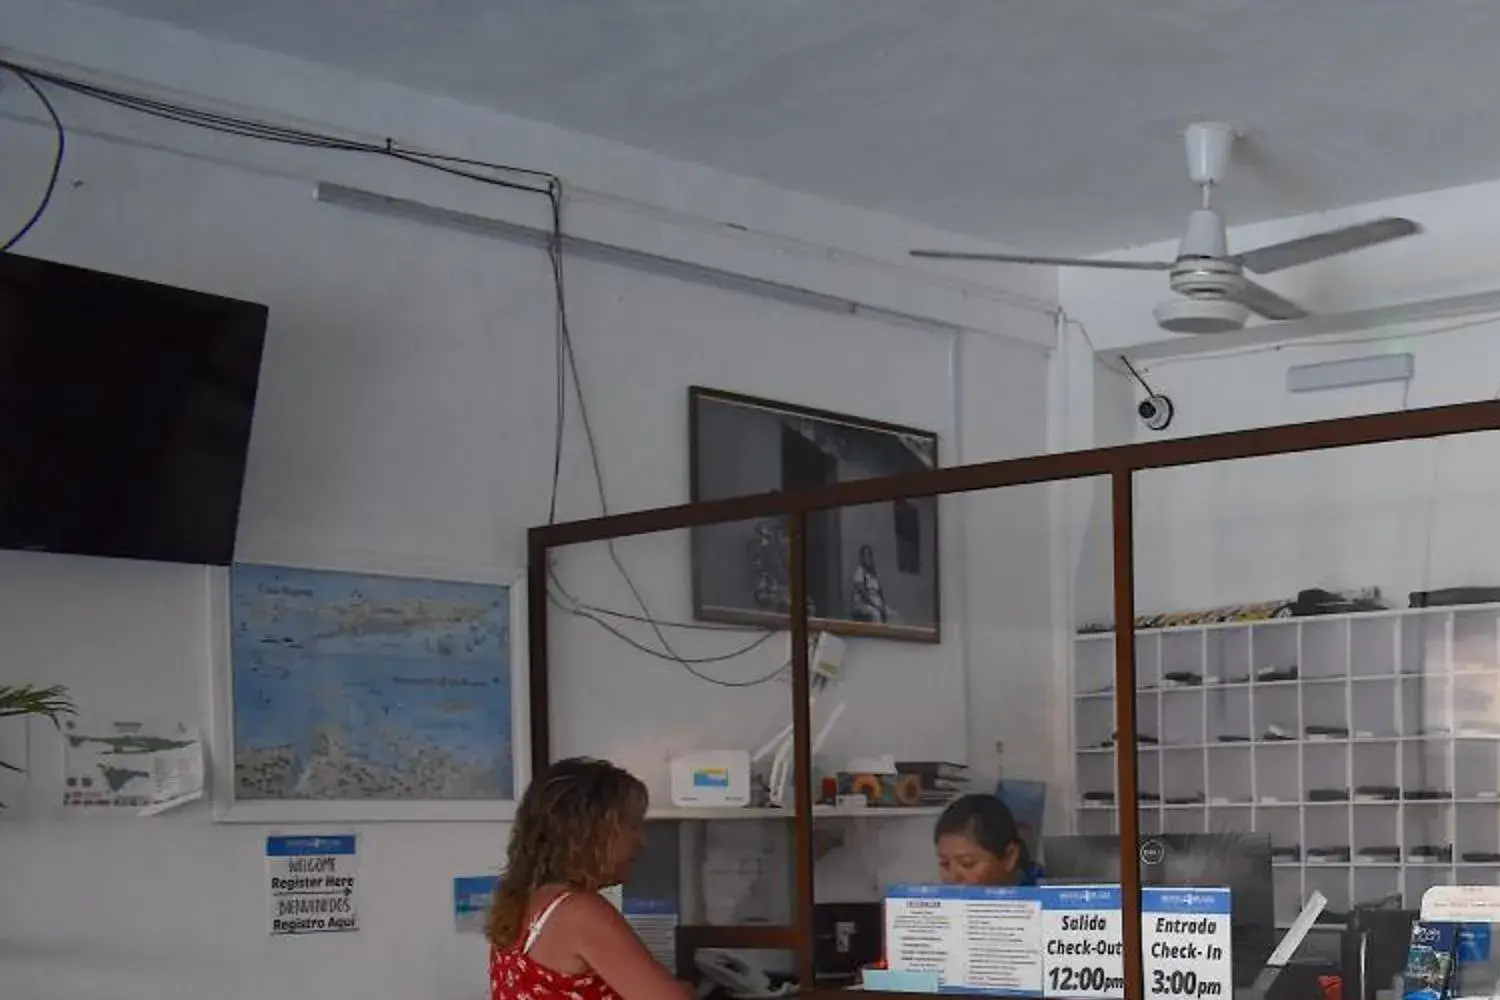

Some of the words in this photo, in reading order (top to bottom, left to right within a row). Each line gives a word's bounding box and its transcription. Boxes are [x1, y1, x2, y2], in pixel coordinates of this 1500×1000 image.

[271, 877, 323, 891] Register
[325, 876, 354, 888] Here
[273, 918, 325, 932] Registro
[1061, 915, 1107, 931] Salida
[1155, 917, 1217, 935] Entrada
[1047, 939, 1122, 956] Check-Out
[1049, 966, 1125, 992] 12:00pm
[1152, 969, 1222, 998] 3:00pm
